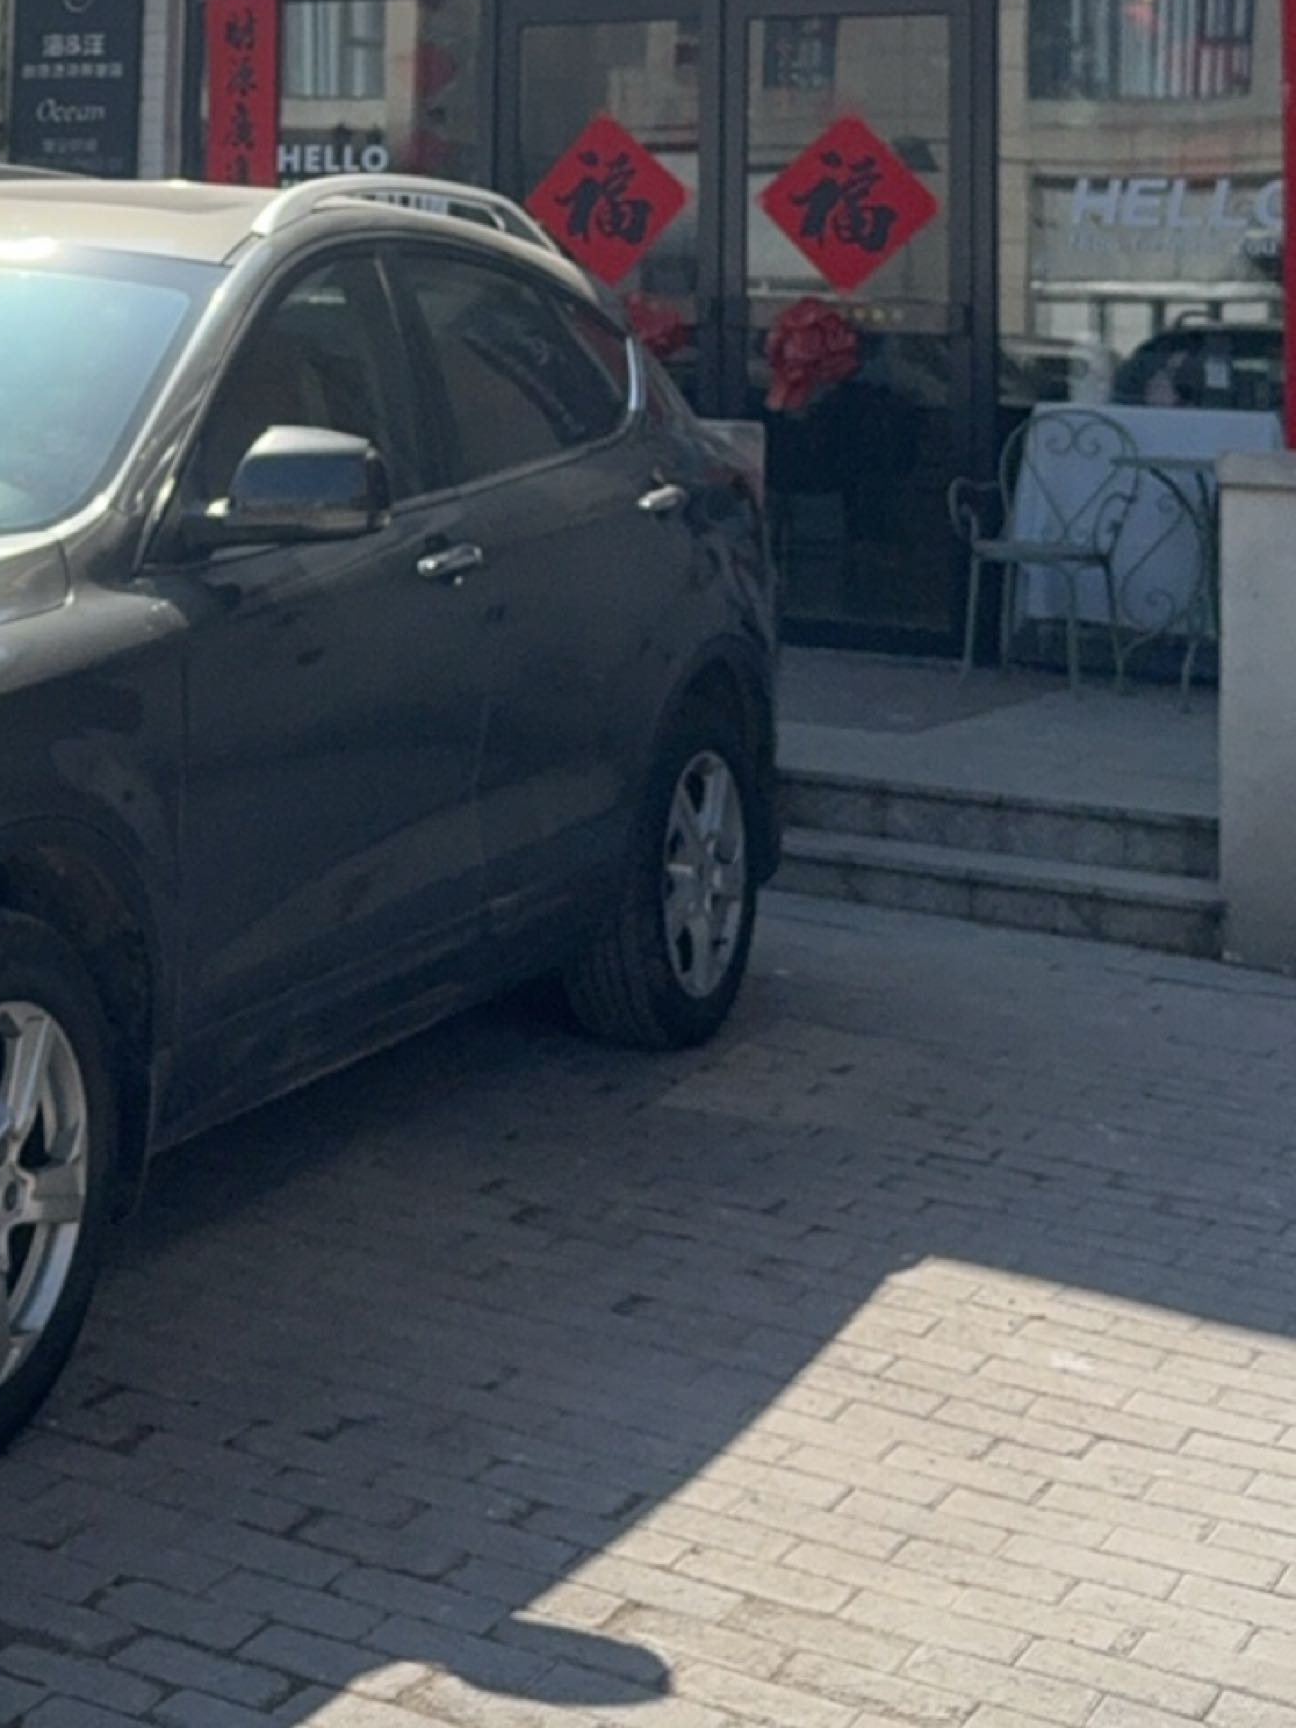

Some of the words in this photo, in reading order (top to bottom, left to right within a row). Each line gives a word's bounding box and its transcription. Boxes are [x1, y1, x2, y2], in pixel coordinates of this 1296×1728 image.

[36, 98, 106, 124] Ocean
[277, 144, 389, 174] HELLO
[554, 149, 655, 246] 福
[792, 149, 897, 253] 福
